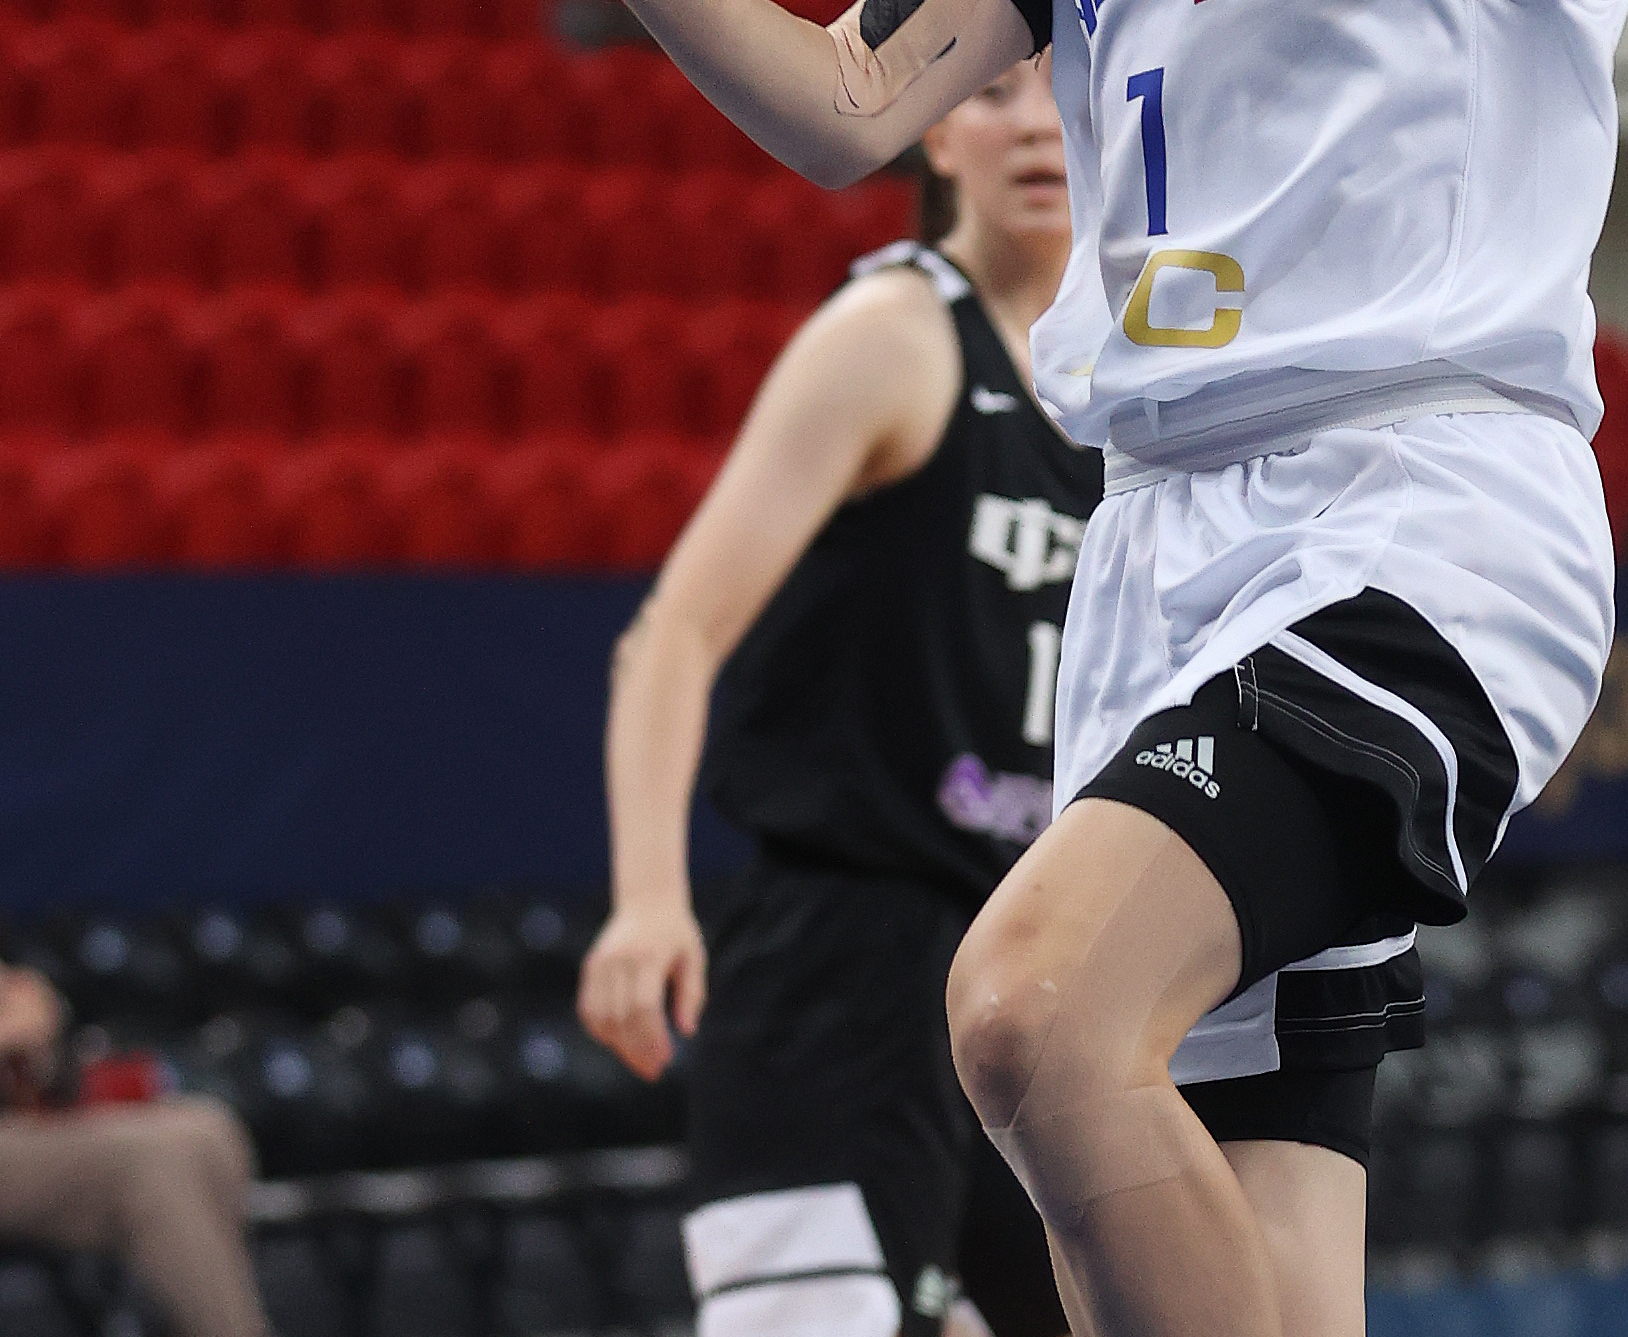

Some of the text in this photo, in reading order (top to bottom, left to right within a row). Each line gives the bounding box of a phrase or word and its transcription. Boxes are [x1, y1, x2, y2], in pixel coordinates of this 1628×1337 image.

[1126, 67, 1168, 236] 1
[1123, 249, 1245, 349] C
[1136, 745, 1221, 800] adidas
